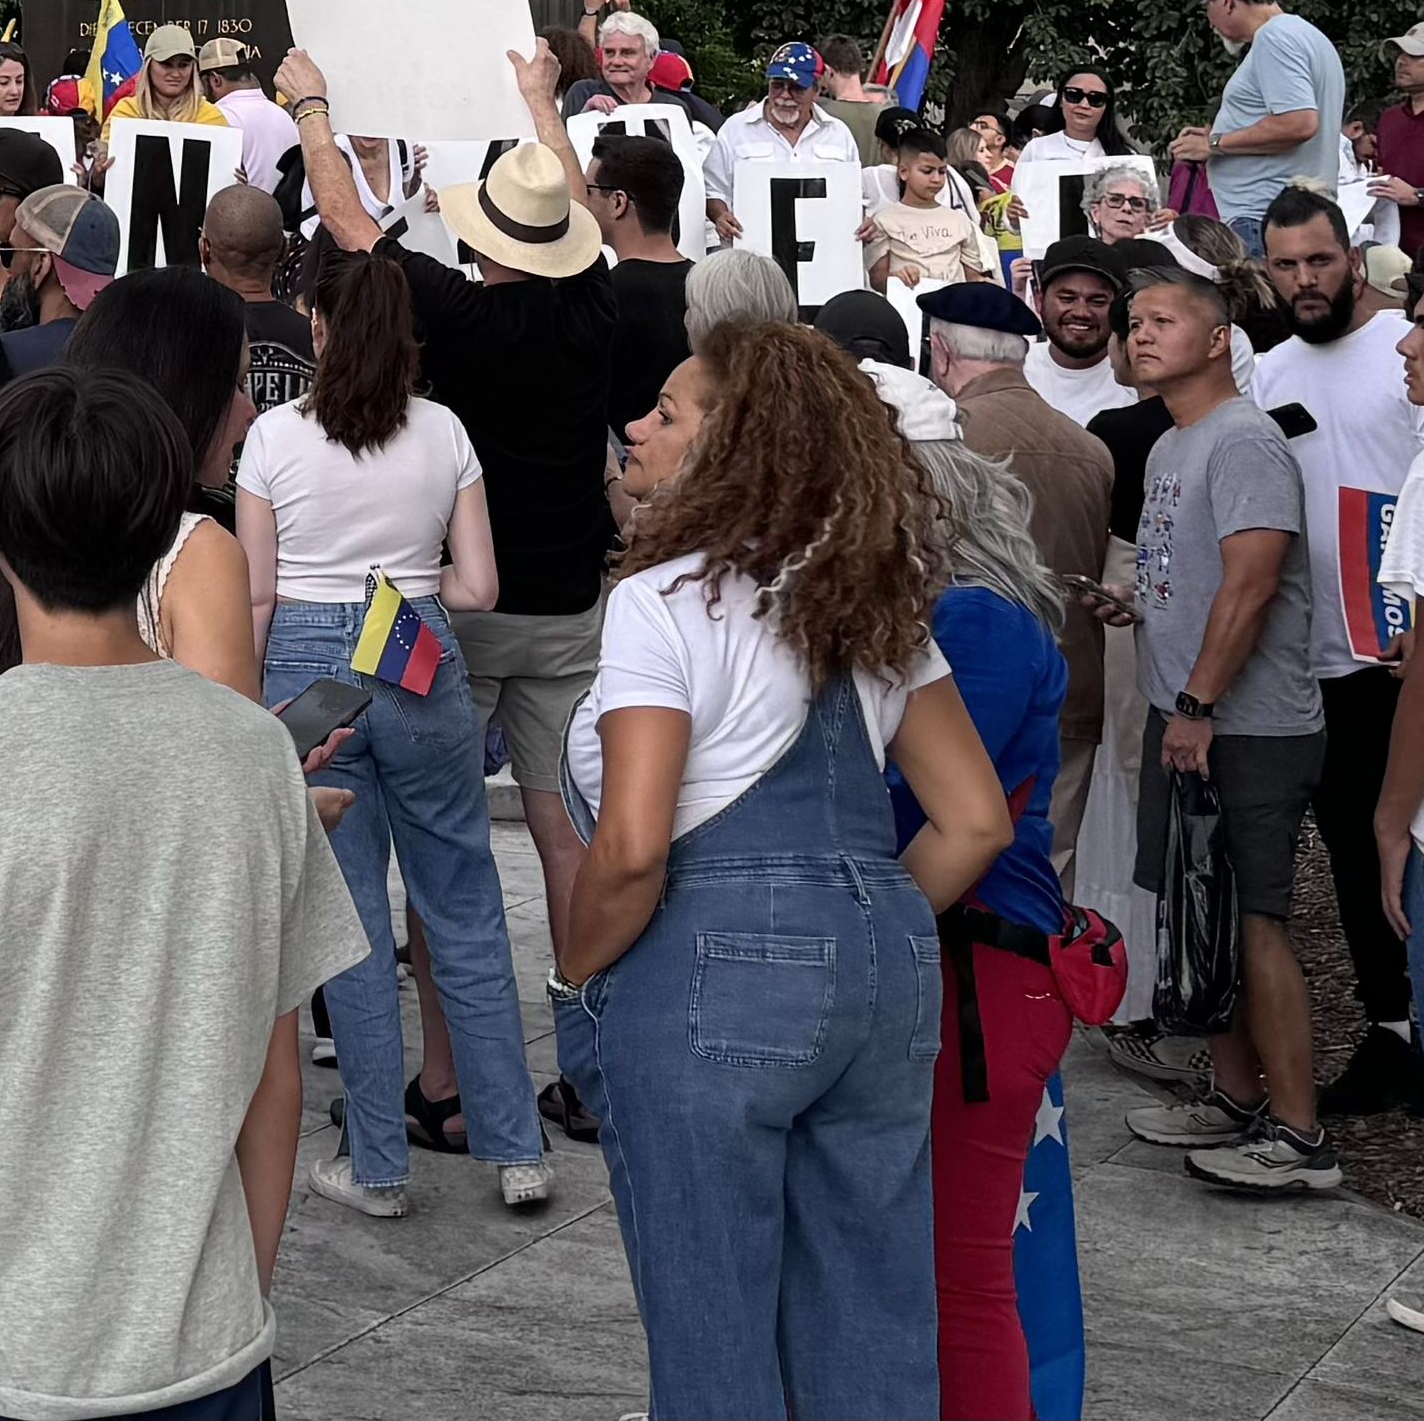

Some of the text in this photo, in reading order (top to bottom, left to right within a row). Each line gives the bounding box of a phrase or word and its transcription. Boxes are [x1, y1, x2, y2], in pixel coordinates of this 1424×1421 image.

[79, 21, 98, 37] DIE
[198, 18, 208, 34] 17
[216, 17, 253, 34] 1830
